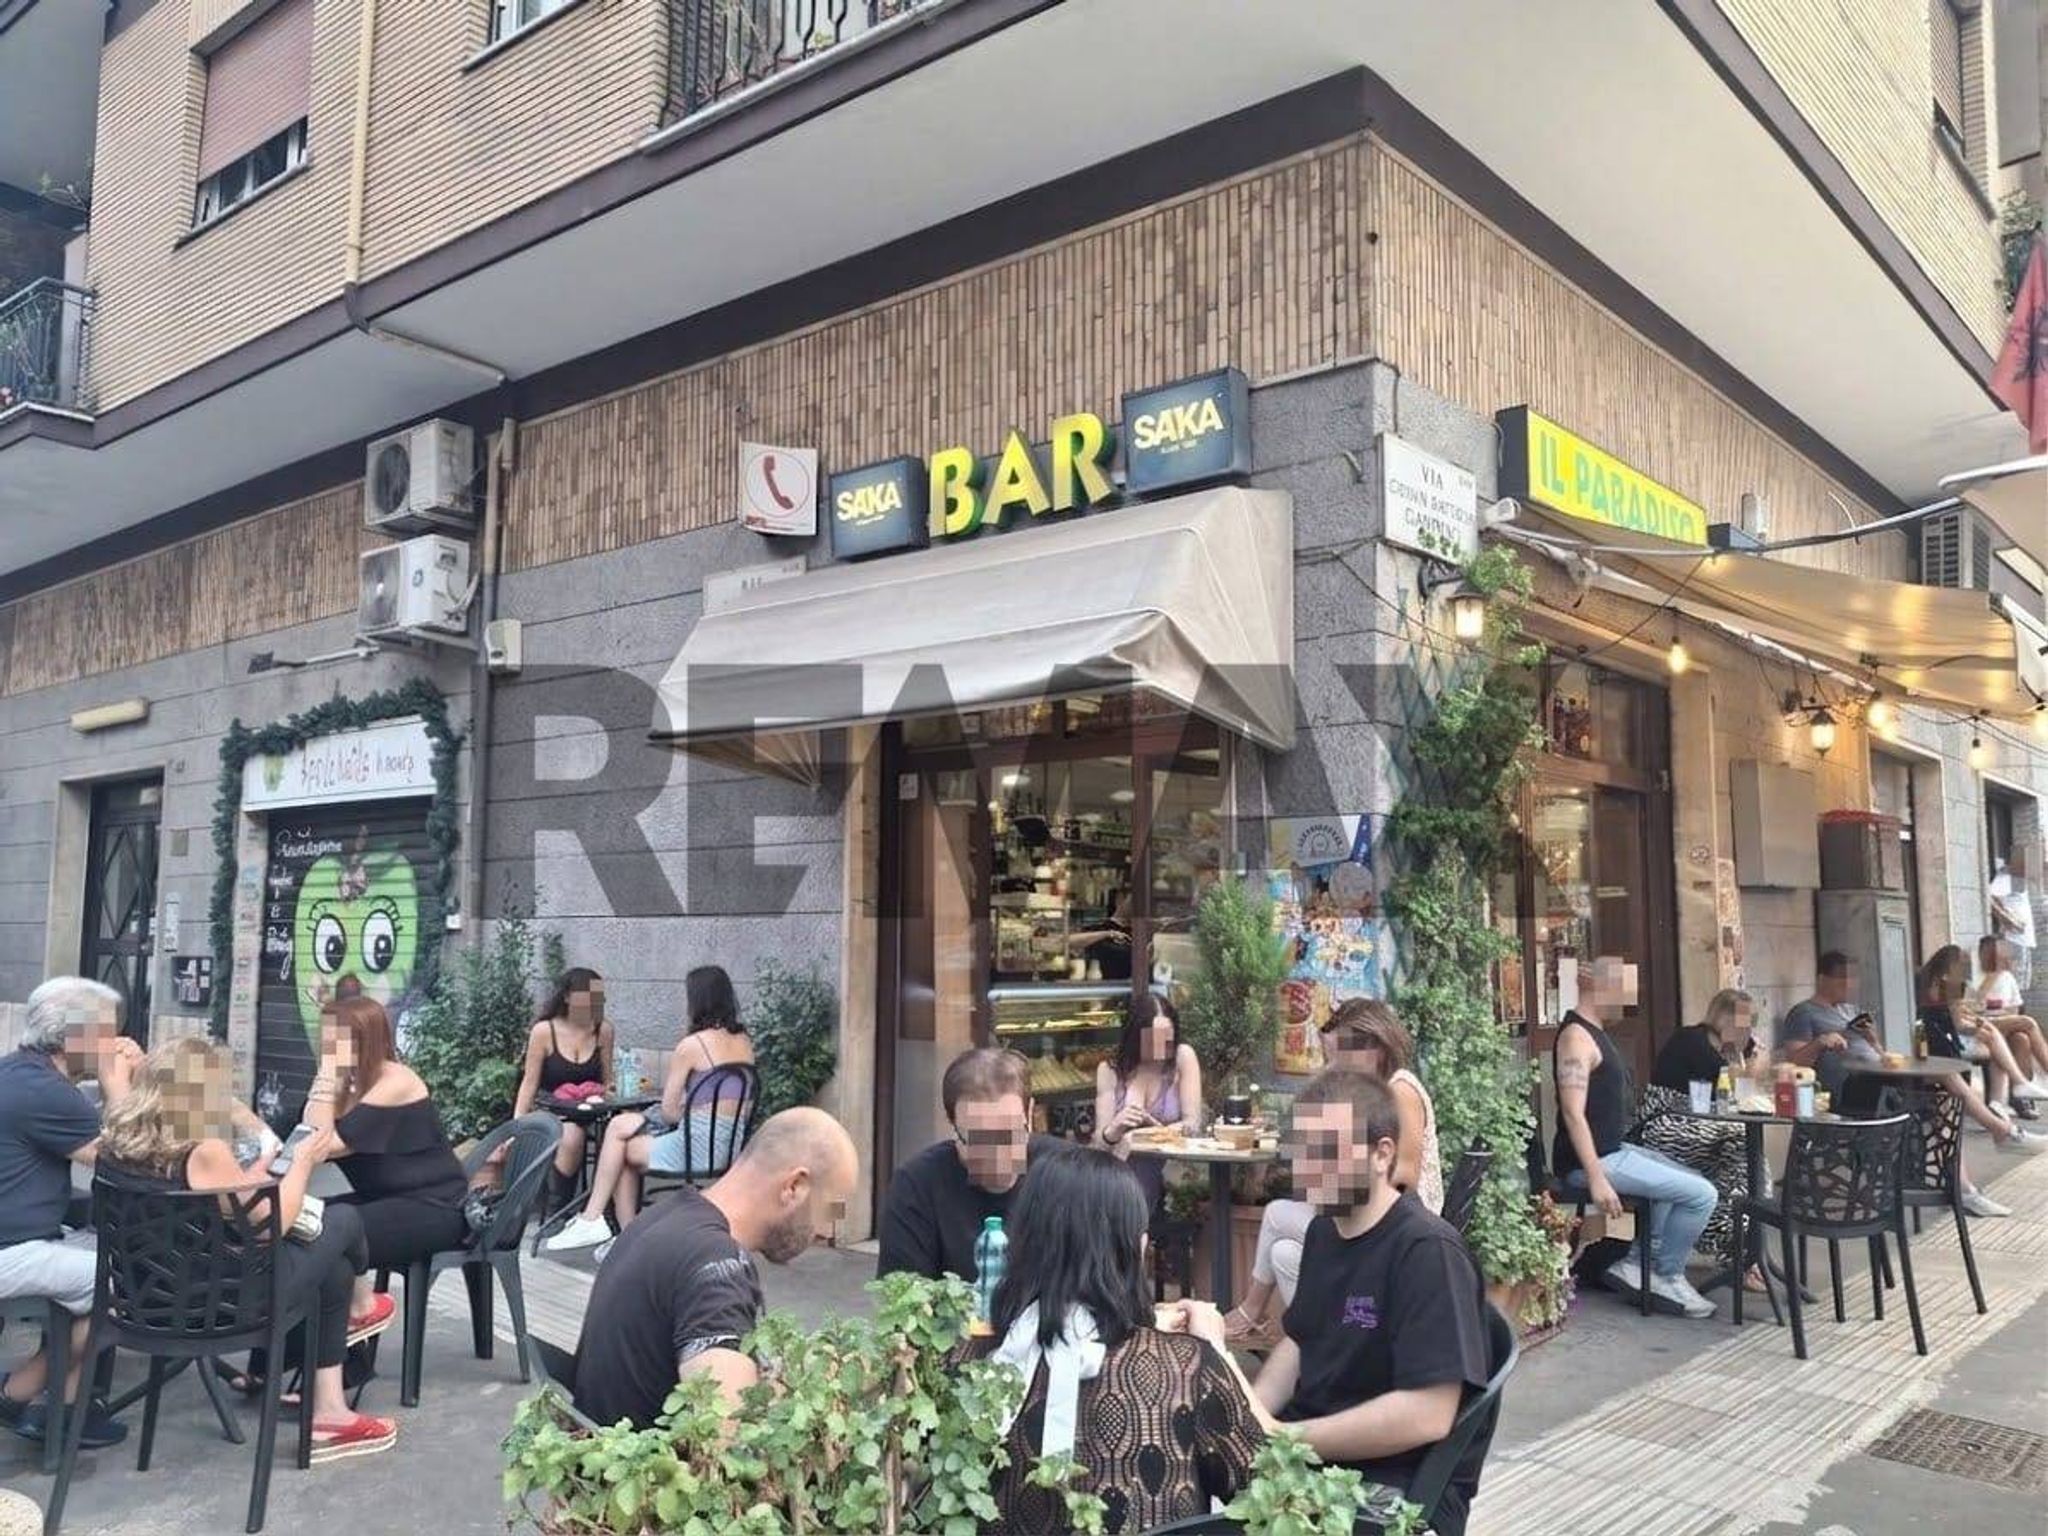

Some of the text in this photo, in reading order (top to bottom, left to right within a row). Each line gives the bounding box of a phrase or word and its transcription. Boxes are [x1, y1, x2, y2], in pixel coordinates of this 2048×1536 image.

[1134, 397, 1224, 450] SAKA
[929, 412, 1113, 538] BAR
[1421, 463, 1444, 491] VIA
[1540, 429, 1565, 496] IL
[836, 480, 903, 522] SAKA
